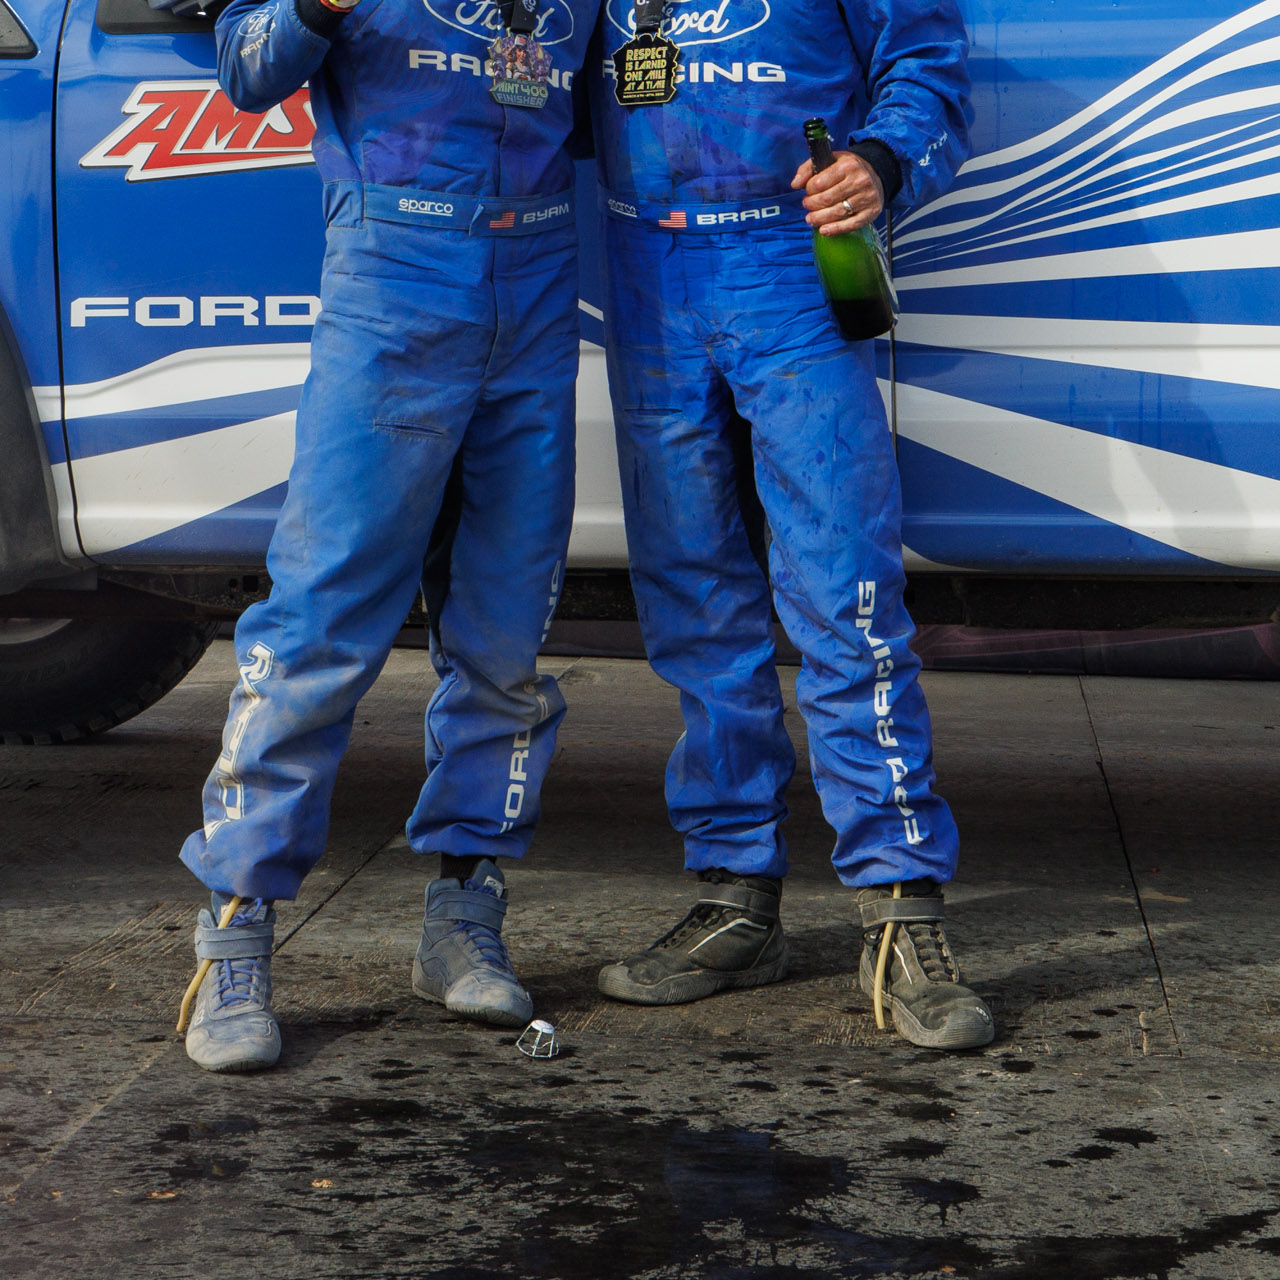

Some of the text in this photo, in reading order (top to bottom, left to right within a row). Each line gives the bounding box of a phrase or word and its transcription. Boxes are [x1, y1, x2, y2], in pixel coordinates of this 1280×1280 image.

[625, 46, 669, 62] RESPECT
[625, 59, 668, 71] IS EARNED
[624, 69, 667, 82] ONE MILE
[495, 81, 548, 98] MINT 400
[623, 80, 666, 91] AT A TIME
[496, 93, 544, 108] FINISHER
[103, 87, 318, 171] AMS
[398, 198, 454, 217] sparco
[523, 202, 570, 224] BYAM
[608, 199, 637, 217] sparco
[696, 205, 781, 226] BRAD
[70, 295, 323, 327] FORD
